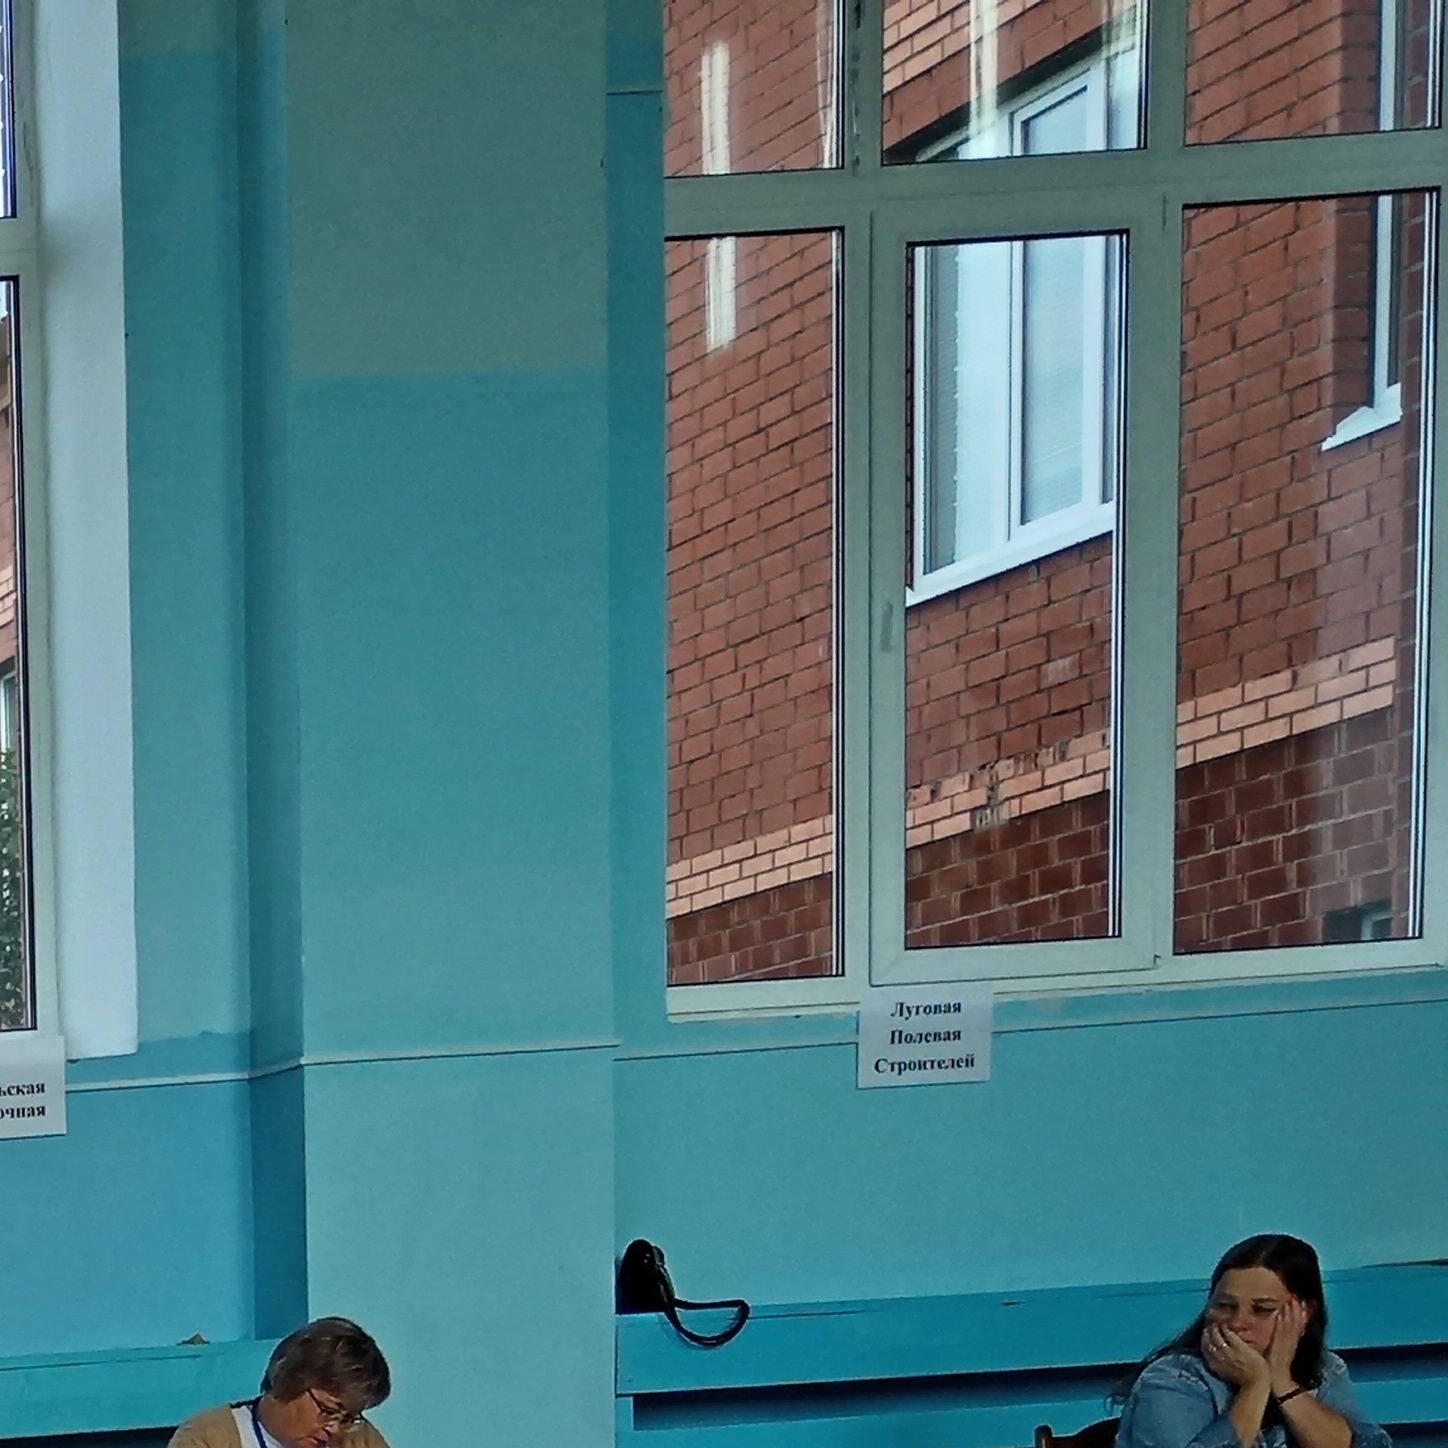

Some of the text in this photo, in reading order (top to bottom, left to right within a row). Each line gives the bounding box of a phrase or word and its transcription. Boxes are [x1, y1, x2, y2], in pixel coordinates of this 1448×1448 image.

[890, 1001, 962, 1020] Луговая
[889, 1029, 962, 1045] Полевая
[873, 1053, 975, 1076] Строителей
